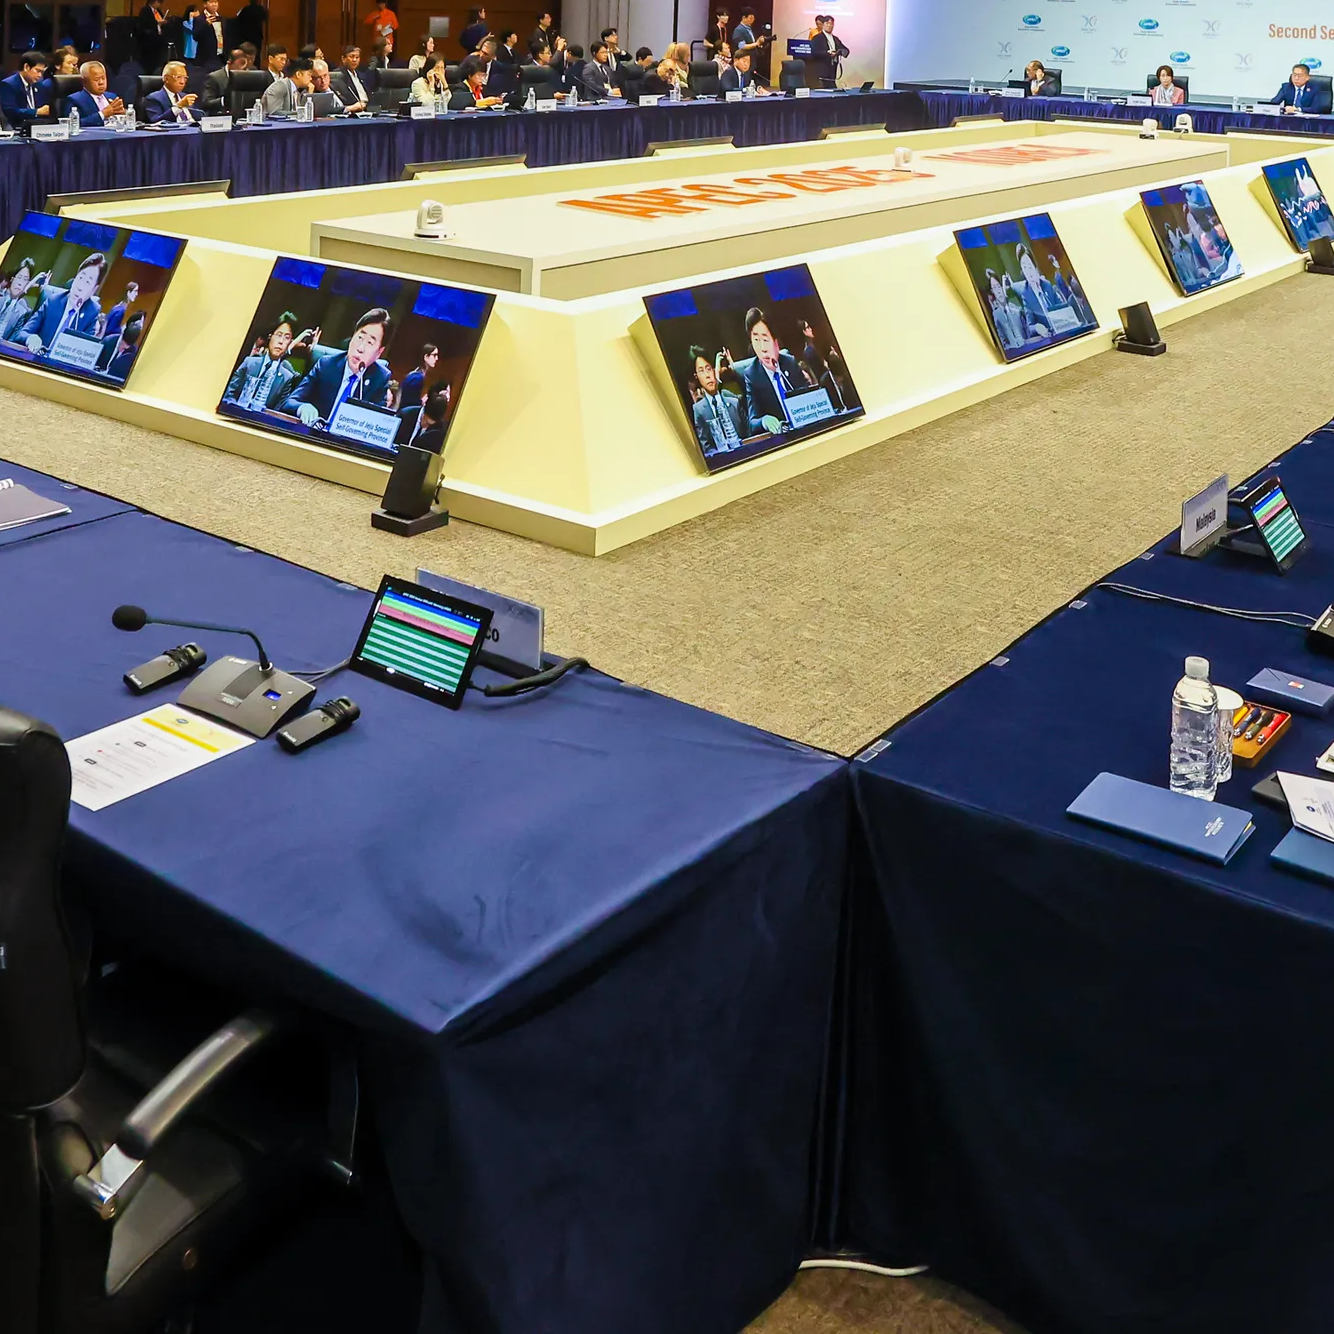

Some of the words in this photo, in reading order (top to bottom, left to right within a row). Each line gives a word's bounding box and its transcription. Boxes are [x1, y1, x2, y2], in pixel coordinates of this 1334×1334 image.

[1268, 23, 1317, 41] Second
[557, 183, 767, 218] APEC
[339, 414, 359, 426] Governor
[374, 424, 392, 435] Special
[368, 430, 388, 443] Province
[1195, 507, 1216, 533] Malaysia
